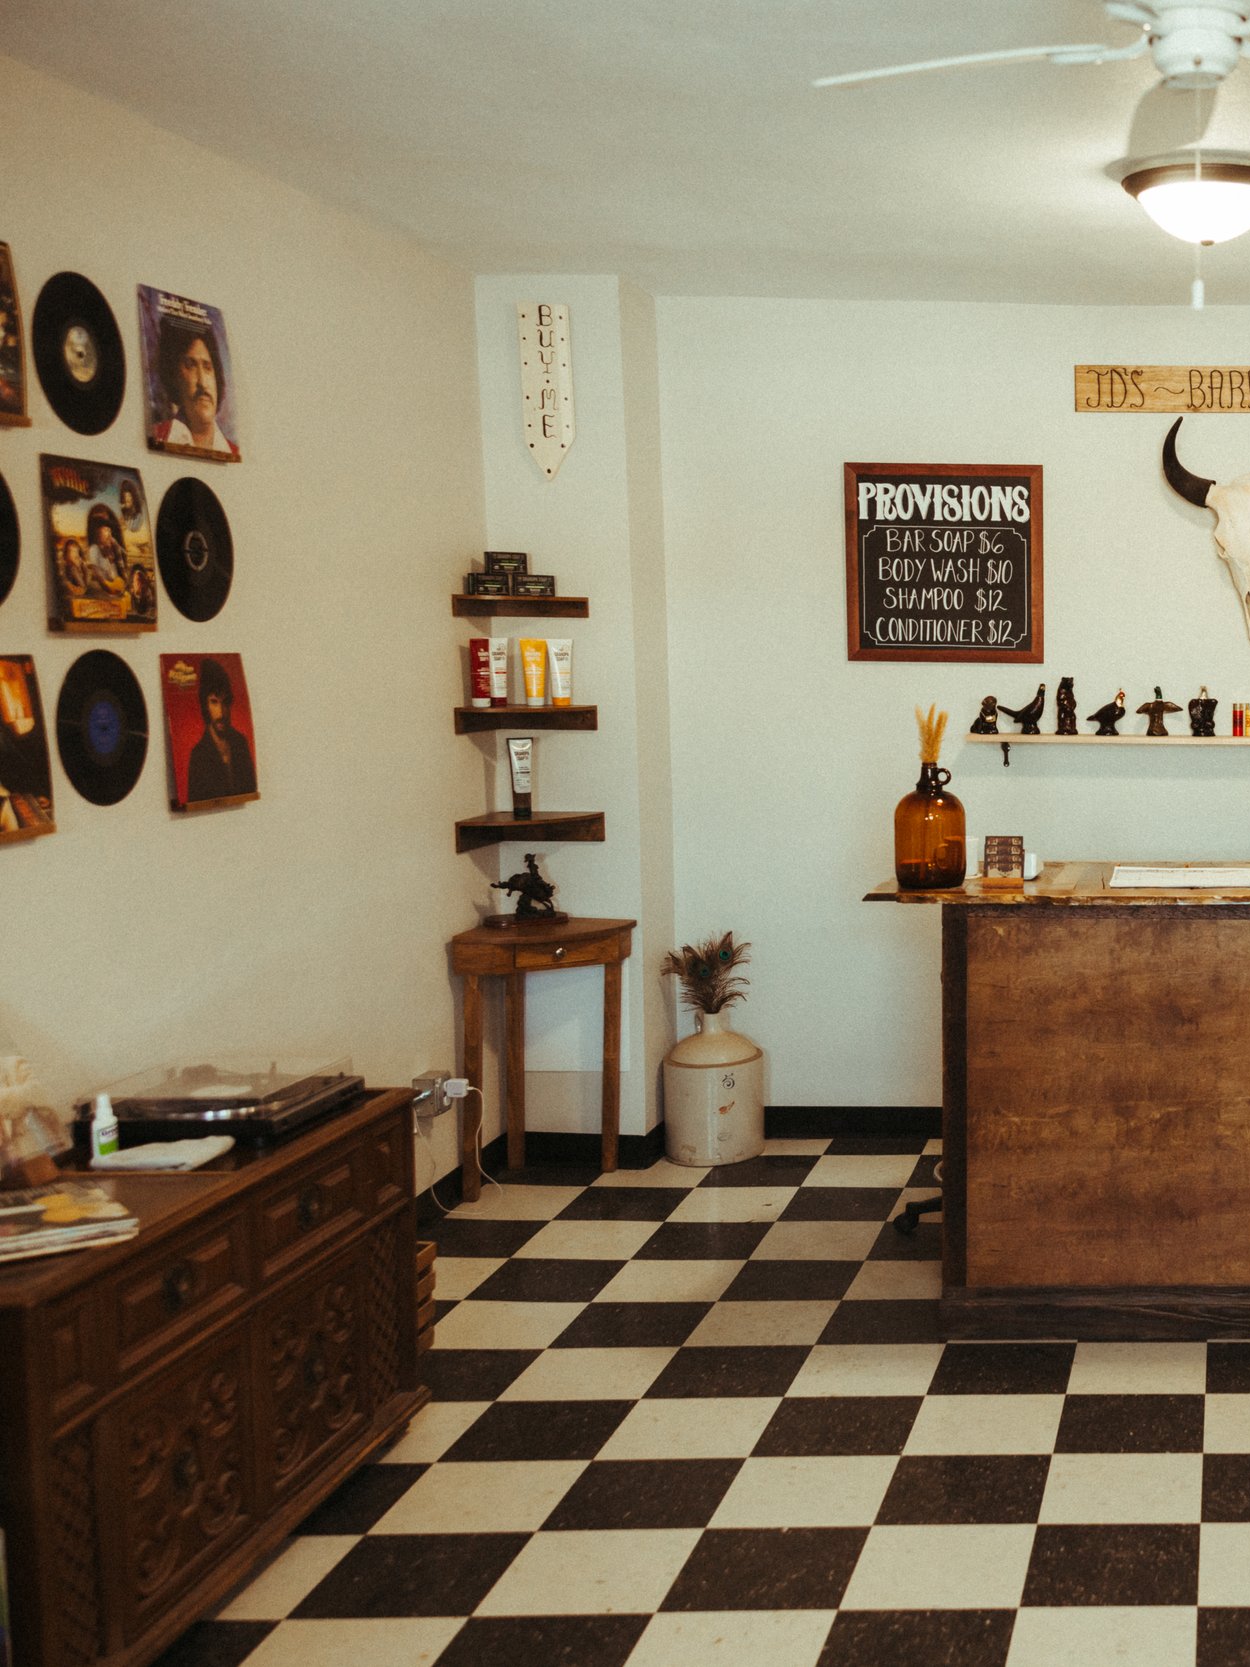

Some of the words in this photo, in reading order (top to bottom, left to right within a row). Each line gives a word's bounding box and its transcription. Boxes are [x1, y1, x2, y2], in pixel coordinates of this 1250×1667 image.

[536, 304, 555, 374] BUY
[538, 388, 559, 439] ME
[857, 482, 1031, 523] PROVISIONS
[886, 528, 926, 553] BAR
[929, 529, 975, 554] SOAP
[978, 530, 1005, 555] $6
[878, 556, 927, 583] BODY
[930, 558, 980, 584] WASH
[985, 559, 1014, 585] $10
[883, 587, 965, 611] SHAMPOO
[974, 588, 1008, 613] $12
[875, 617, 984, 643] CONDITIONER
[986, 619, 1016, 645] $12
